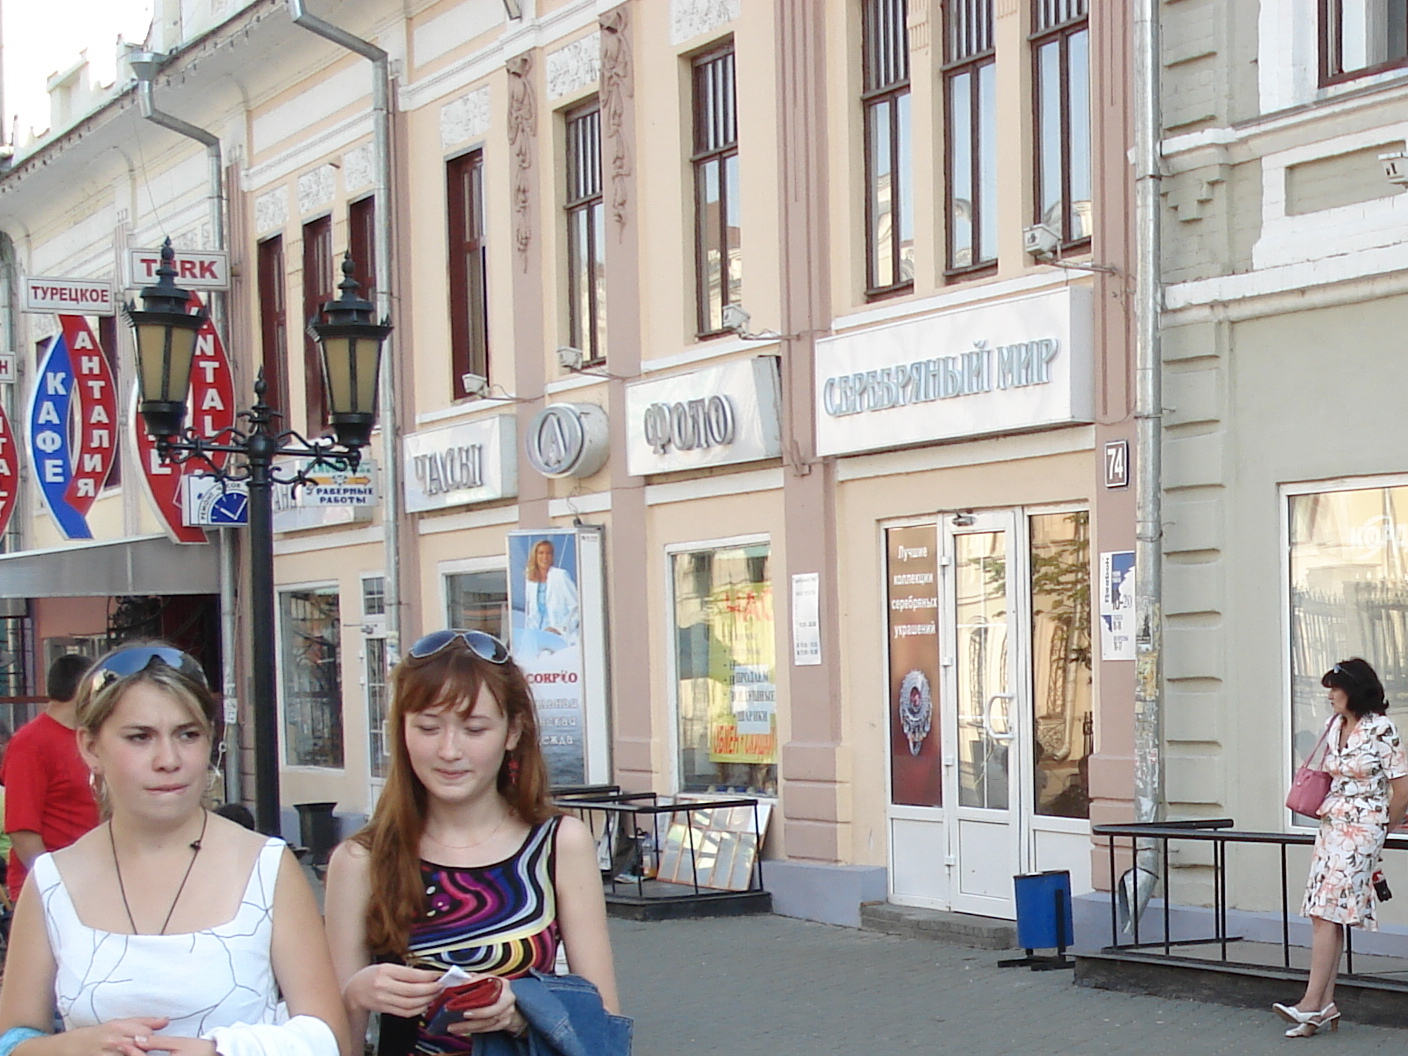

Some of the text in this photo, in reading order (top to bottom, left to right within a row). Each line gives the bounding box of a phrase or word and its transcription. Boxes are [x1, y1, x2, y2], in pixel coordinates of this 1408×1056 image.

[140, 258, 219, 279] TRK
[31, 286, 109, 304] ТУРЕЦКОЕ
[823, 338, 1059, 418] СЕРЕБРЯНЫЙ МИР
[36, 372, 67, 483] КАФЕ
[74, 331, 110, 498] АНТАЛИЯ
[643, 394, 735, 455] ФОТО
[413, 443, 484, 496] ЧАСЫ
[1107, 447, 1124, 480] 74
[320, 496, 366, 504] РАБОТЫ
[898, 545, 928, 562] Лучшие
